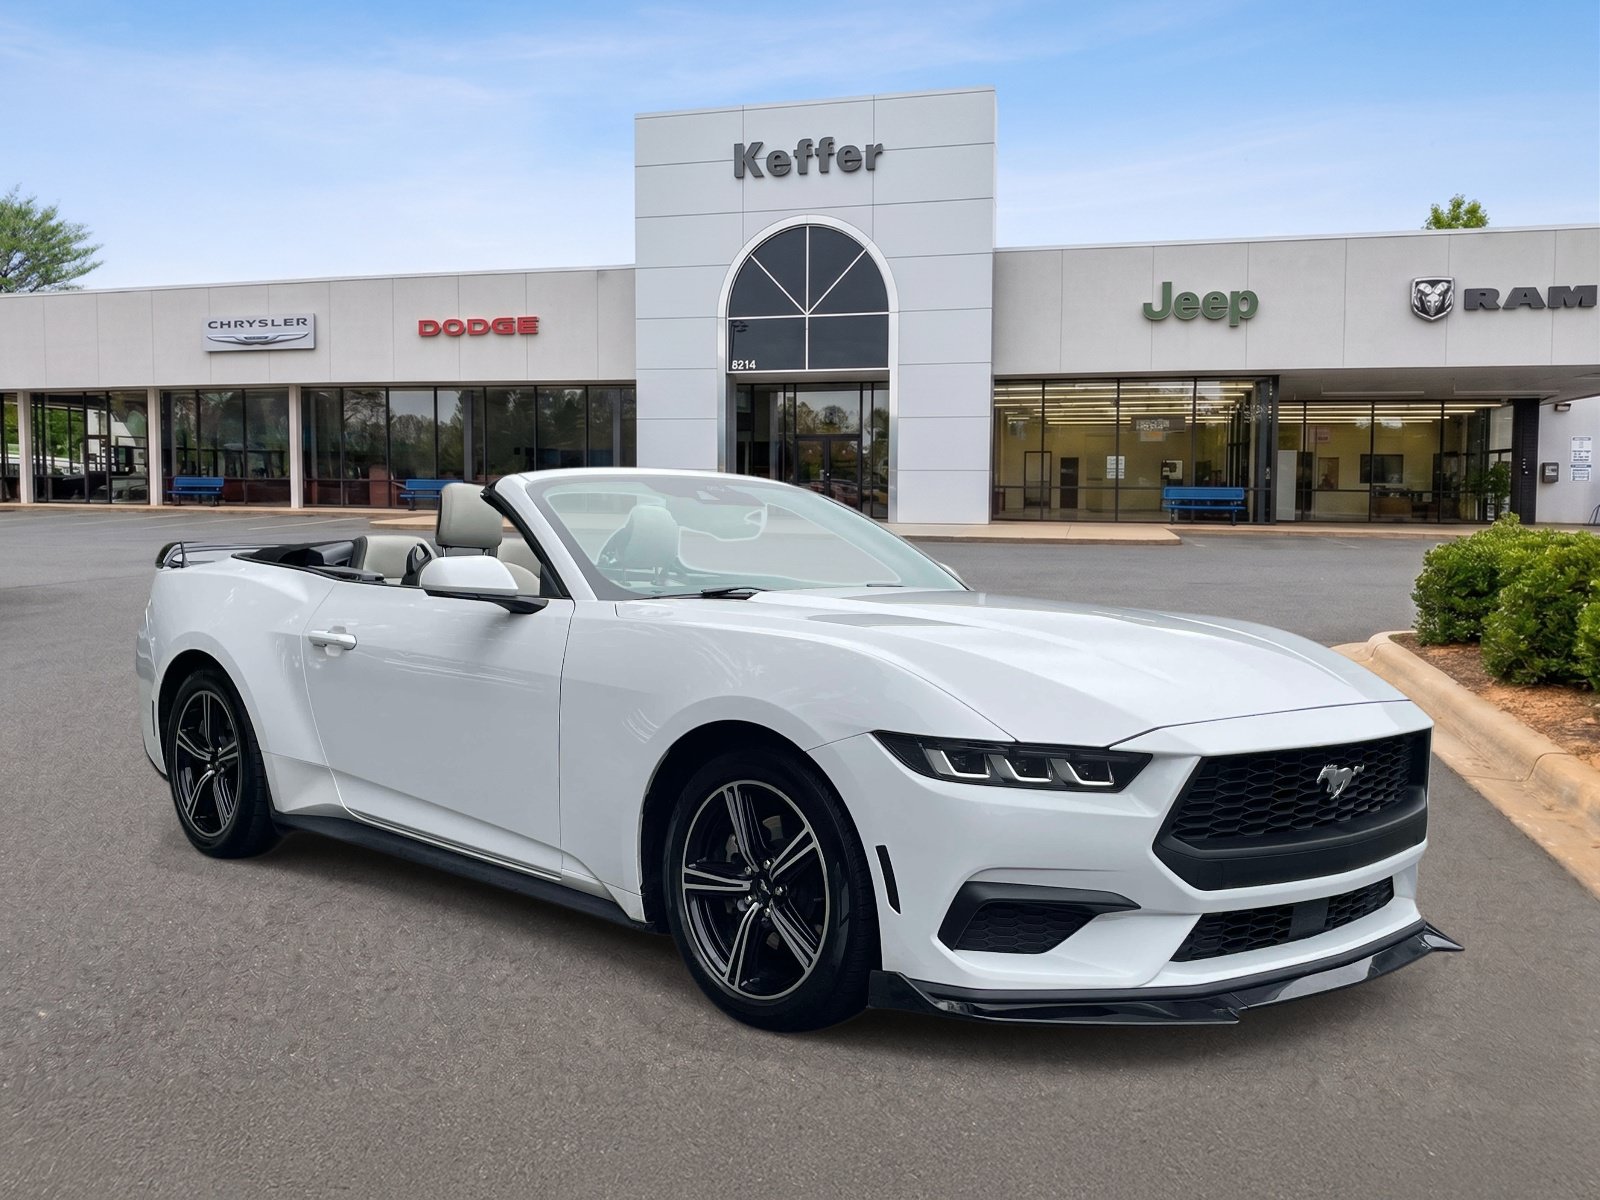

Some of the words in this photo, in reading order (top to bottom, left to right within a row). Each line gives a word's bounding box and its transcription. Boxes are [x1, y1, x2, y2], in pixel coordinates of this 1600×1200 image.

[734, 137, 883, 178] Keffer
[1143, 281, 1258, 327] Jeep
[1464, 285, 1597, 310] RAM
[208, 318, 308, 329] CHRYSLER
[418, 317, 539, 336] DODGE
[732, 360, 756, 369] 8214
